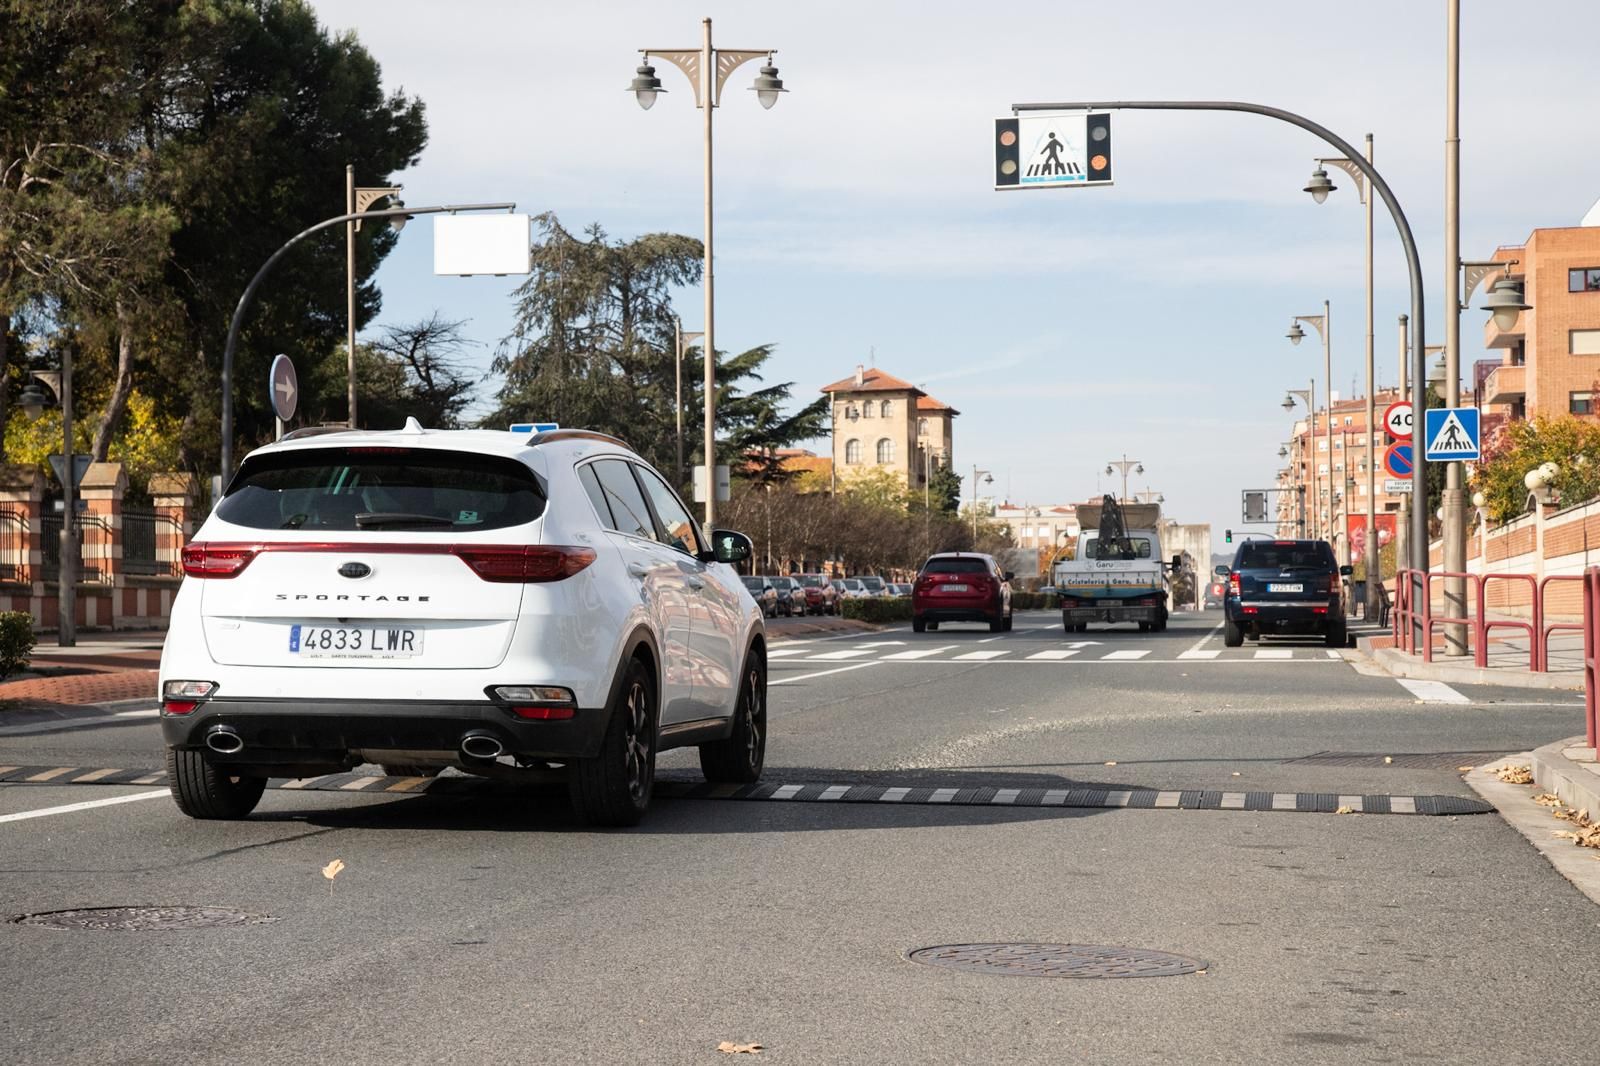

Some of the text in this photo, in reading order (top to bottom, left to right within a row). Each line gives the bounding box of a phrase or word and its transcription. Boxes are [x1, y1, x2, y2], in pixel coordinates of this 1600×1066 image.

[1391, 414, 1413, 426] 40
[275, 594, 431, 602] SPORTAGE
[304, 629, 415, 651] 4833 LWR
